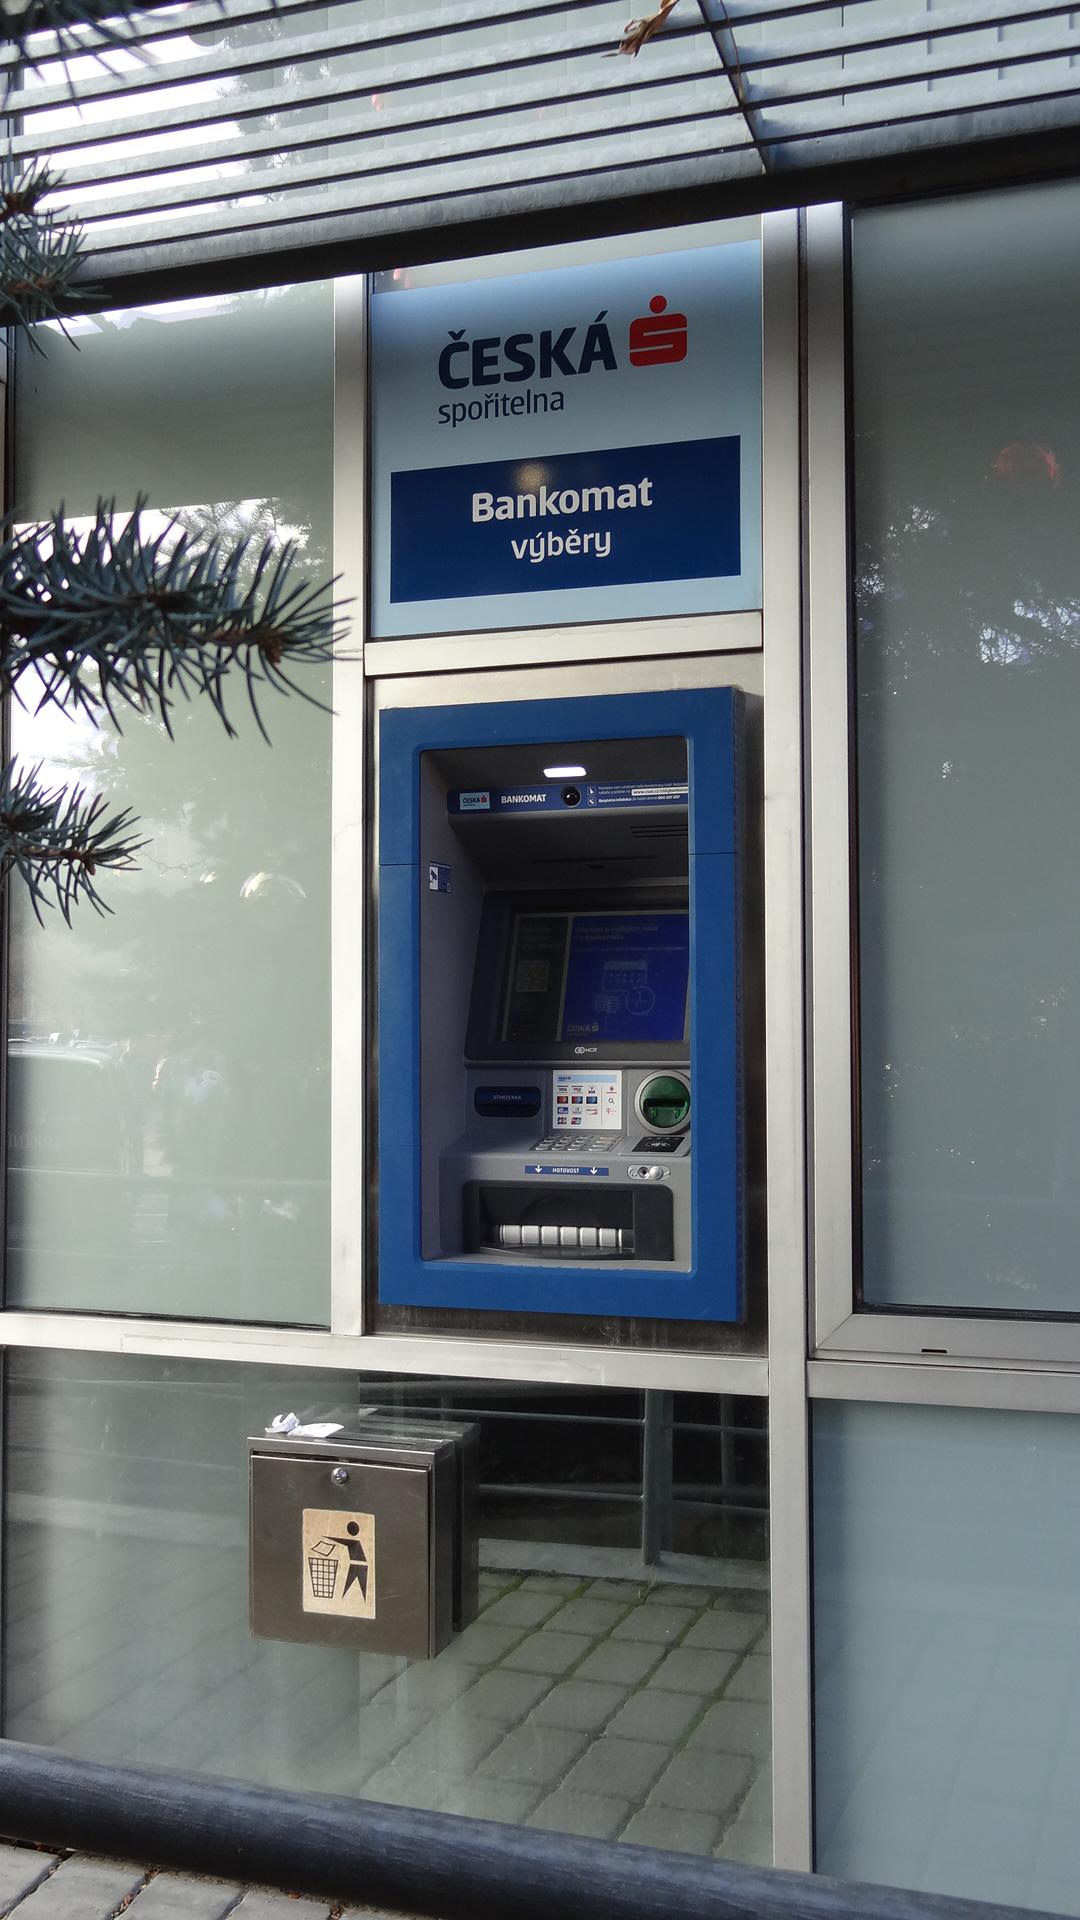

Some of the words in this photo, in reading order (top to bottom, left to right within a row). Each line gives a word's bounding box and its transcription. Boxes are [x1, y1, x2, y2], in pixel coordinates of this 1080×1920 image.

[438, 310, 618, 390] ČESKÁ
[438, 388, 565, 428] spořitelna
[471, 477, 653, 523] Bankomat
[511, 529, 612, 564] výběry
[501, 793, 547, 804] BANKOMAT
